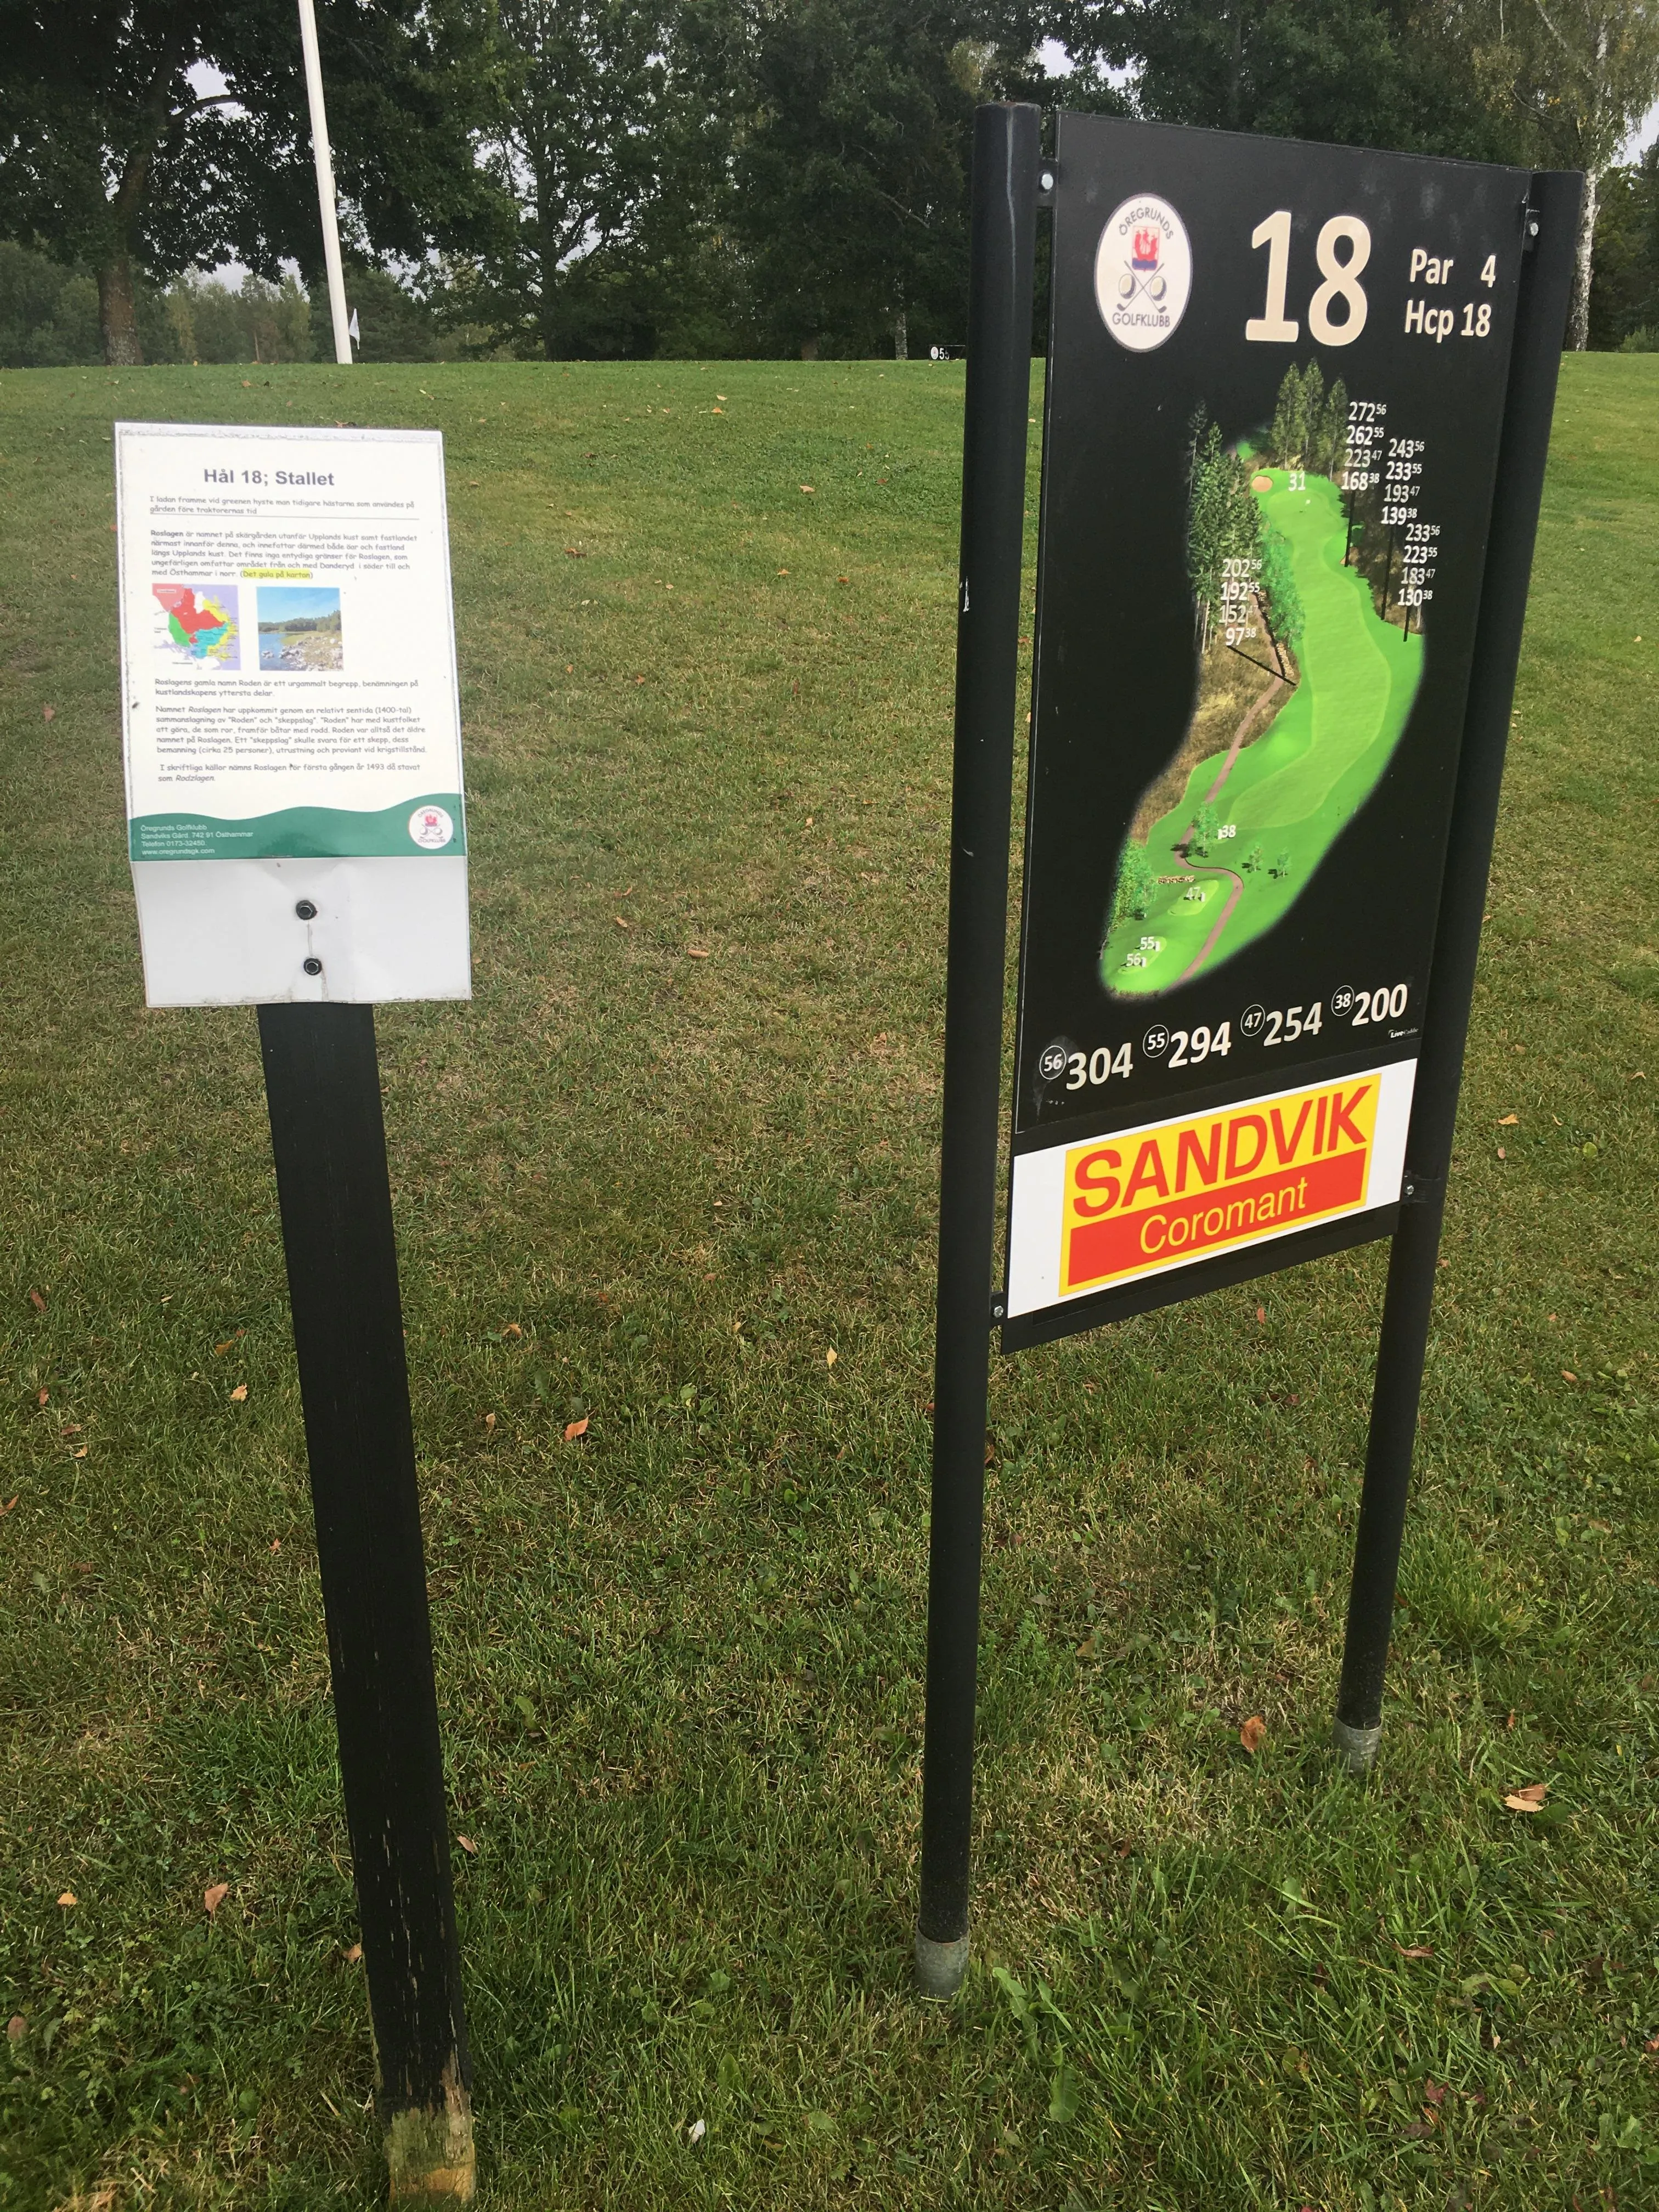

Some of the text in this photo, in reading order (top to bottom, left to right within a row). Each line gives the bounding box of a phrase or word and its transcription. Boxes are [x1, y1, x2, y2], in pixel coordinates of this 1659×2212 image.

[1119, 206, 1173, 240] ÖREGRUNDS
[1409, 249, 1496, 288] Par 4
[1245, 210, 1372, 346] 18
[1112, 312, 1171, 328] GOLFKLUBB
[1404, 299, 1492, 343] Hcp 18
[204, 468, 335, 486] Hål 18; Stallet
[1288, 471, 1306, 492] 31
[292, 499, 320, 507] tidigare
[406, 501, 414, 509] på
[225, 531, 234, 539] på
[235, 531, 276, 540] skärgården
[308, 533, 341, 541] Upplands
[151, 549, 170, 557] längs
[172, 550, 206, 558] Upplands
[281, 552, 313, 560] entydiga
[258, 571, 274, 579] gula
[275, 570, 284, 579] på
[155, 679, 192, 687] Roslagens
[194, 679, 216, 687] gamla
[410, 679, 418, 688] på
[155, 689, 217, 697] kustlandskapens
[188, 706, 222, 714] Roslagen
[157, 746, 196, 754] bemanning
[167, 764, 203, 772] skriftliga
[329, 763, 354, 772] gången
[1043, 983, 1408, 1091] 56 304 55 294 47 254 38 200
[1073, 1085, 1372, 1218] SANDVIK
[1139, 1177, 1308, 1254] Coromant
